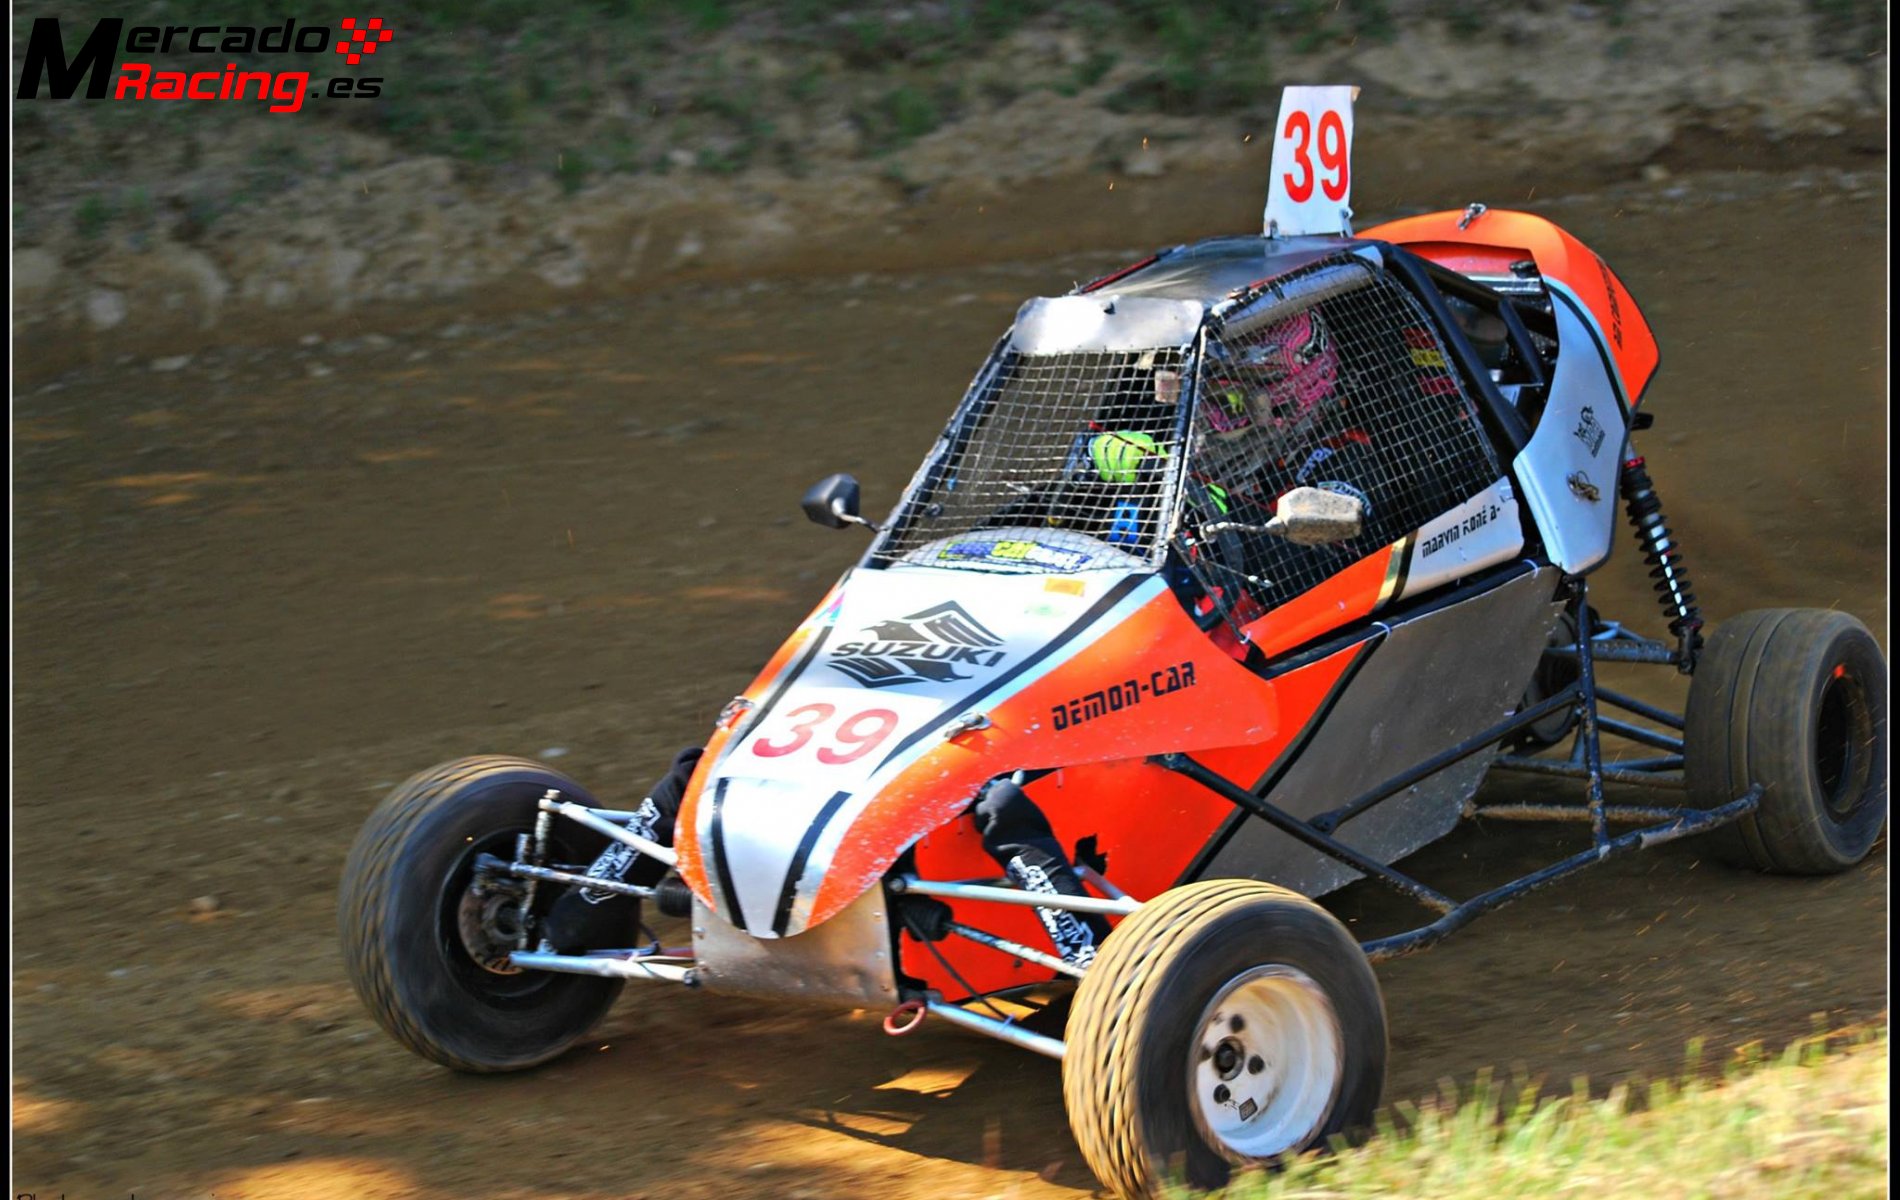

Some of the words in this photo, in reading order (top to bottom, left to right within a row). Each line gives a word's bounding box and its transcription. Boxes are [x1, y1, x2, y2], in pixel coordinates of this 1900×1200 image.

[1283, 109, 1349, 203] 39
[830, 641, 1007, 668] SUZUKI
[1051, 661, 1197, 731] DEMON-CAR
[751, 702, 899, 765] 39
